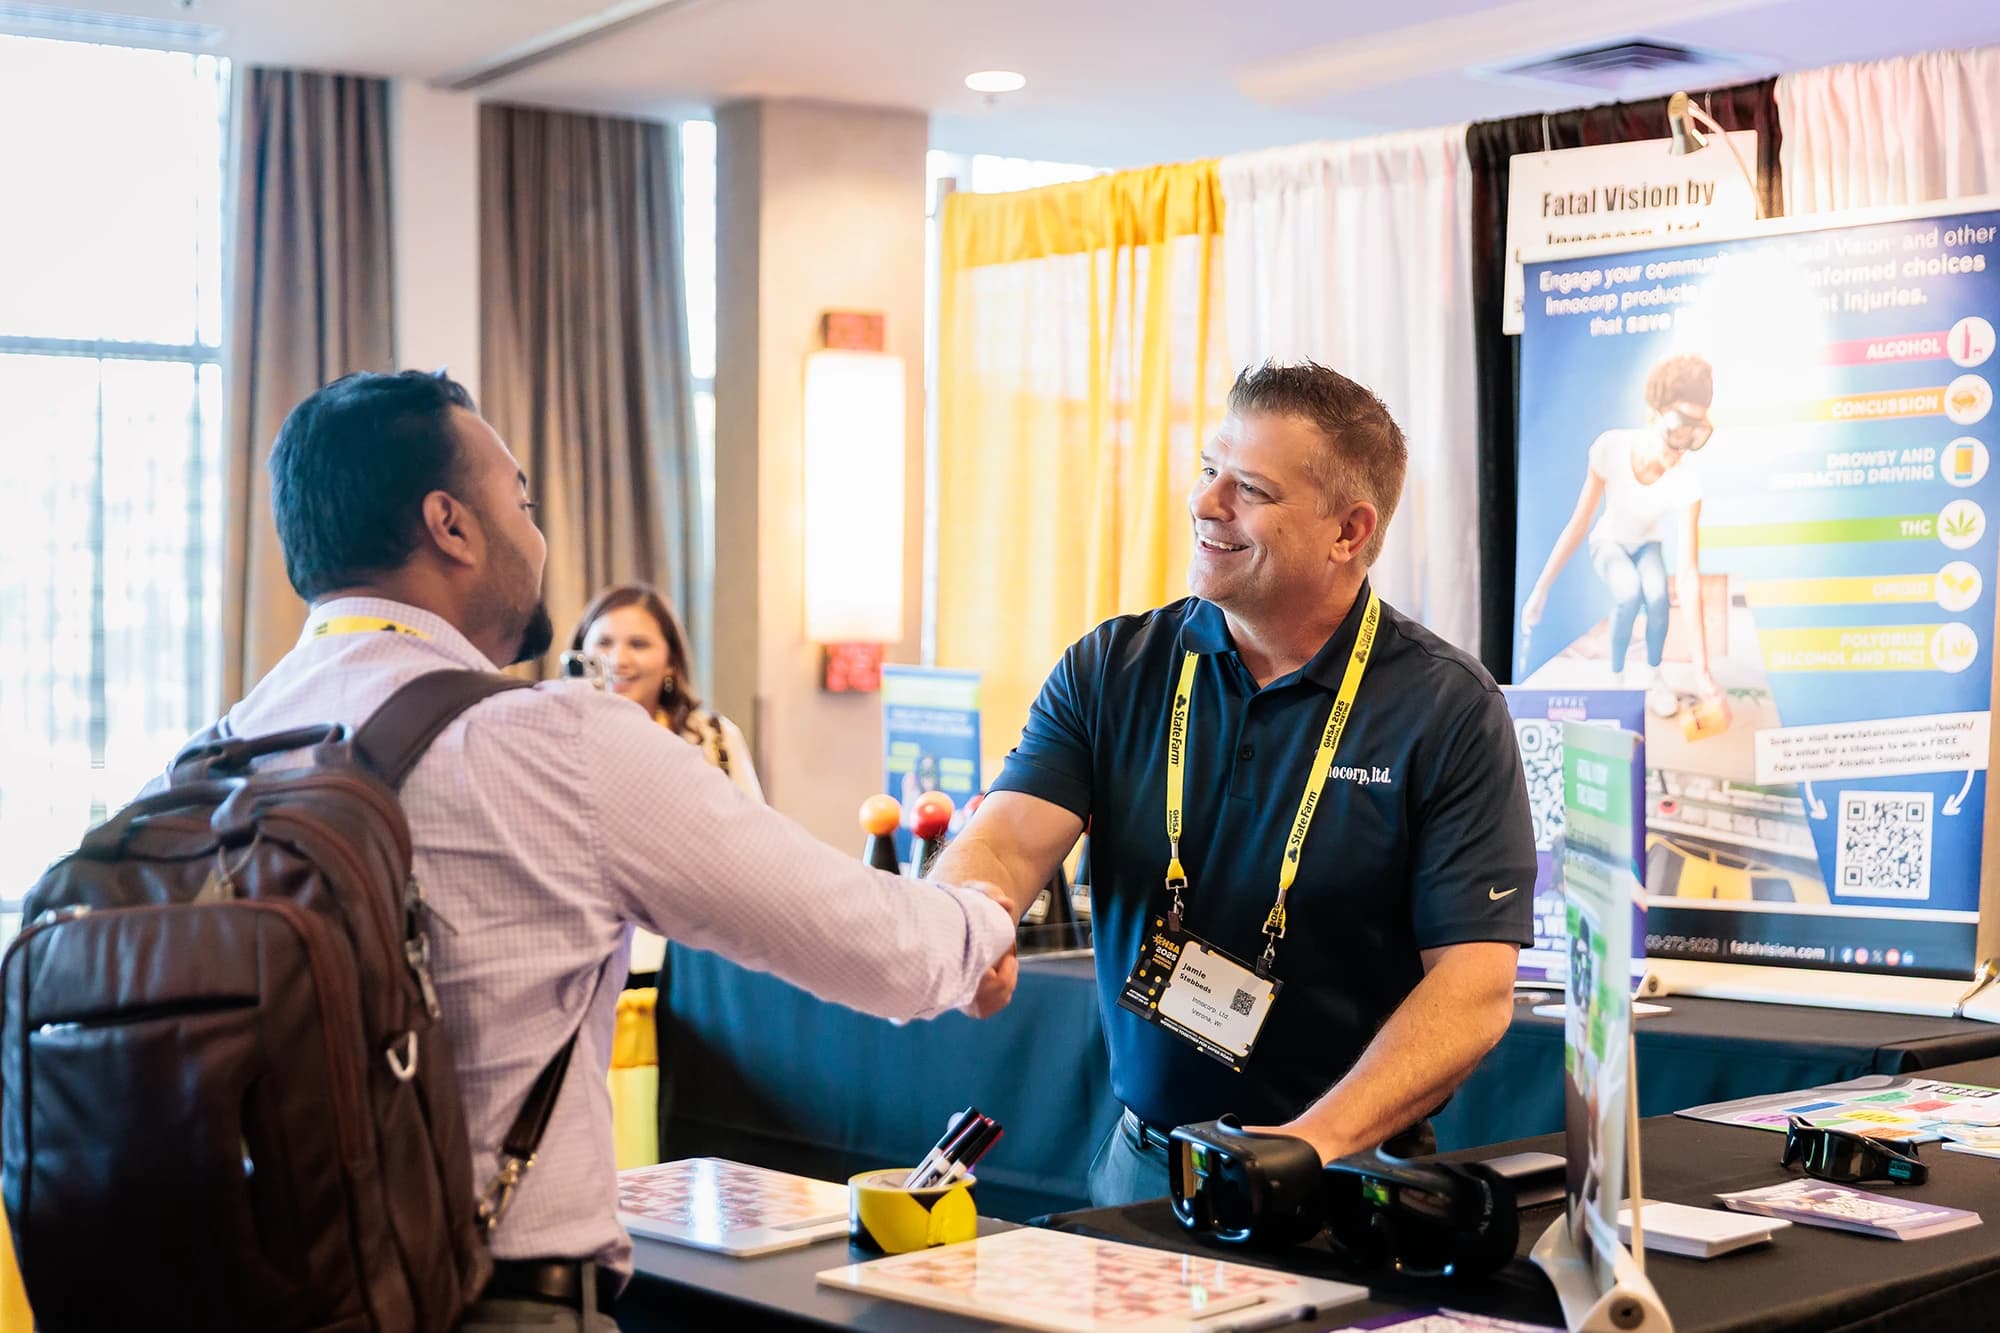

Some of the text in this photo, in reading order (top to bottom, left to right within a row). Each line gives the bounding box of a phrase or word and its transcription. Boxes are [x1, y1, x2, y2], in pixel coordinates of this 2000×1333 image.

[1543, 179, 1715, 218] Fatal Vision by
[1539, 270, 1602, 294] Engage
[1604, 265, 1643, 289] your
[1902, 228, 1939, 248] and
[1943, 224, 1997, 247] other
[1546, 294, 1618, 316] Innocorp
[1902, 253, 1986, 278] choices
[1590, 316, 1623, 337] that
[1625, 313, 1672, 334] save
[1844, 285, 1927, 313] injuries.
[1866, 338, 1941, 360] ALCOHOL
[1831, 395, 1938, 418] CONCUSSION
[1827, 447, 1936, 470] DROWSY AND
[1867, 464, 1935, 485] DRIVING
[1900, 519, 1932, 537] THC
[1323, 700, 1345, 748] GHSA 2025
[1155, 946, 1178, 961] 2025
[1730, 940, 1826, 960] fatalvision.com
[1182, 963, 1207, 980] Jamie
